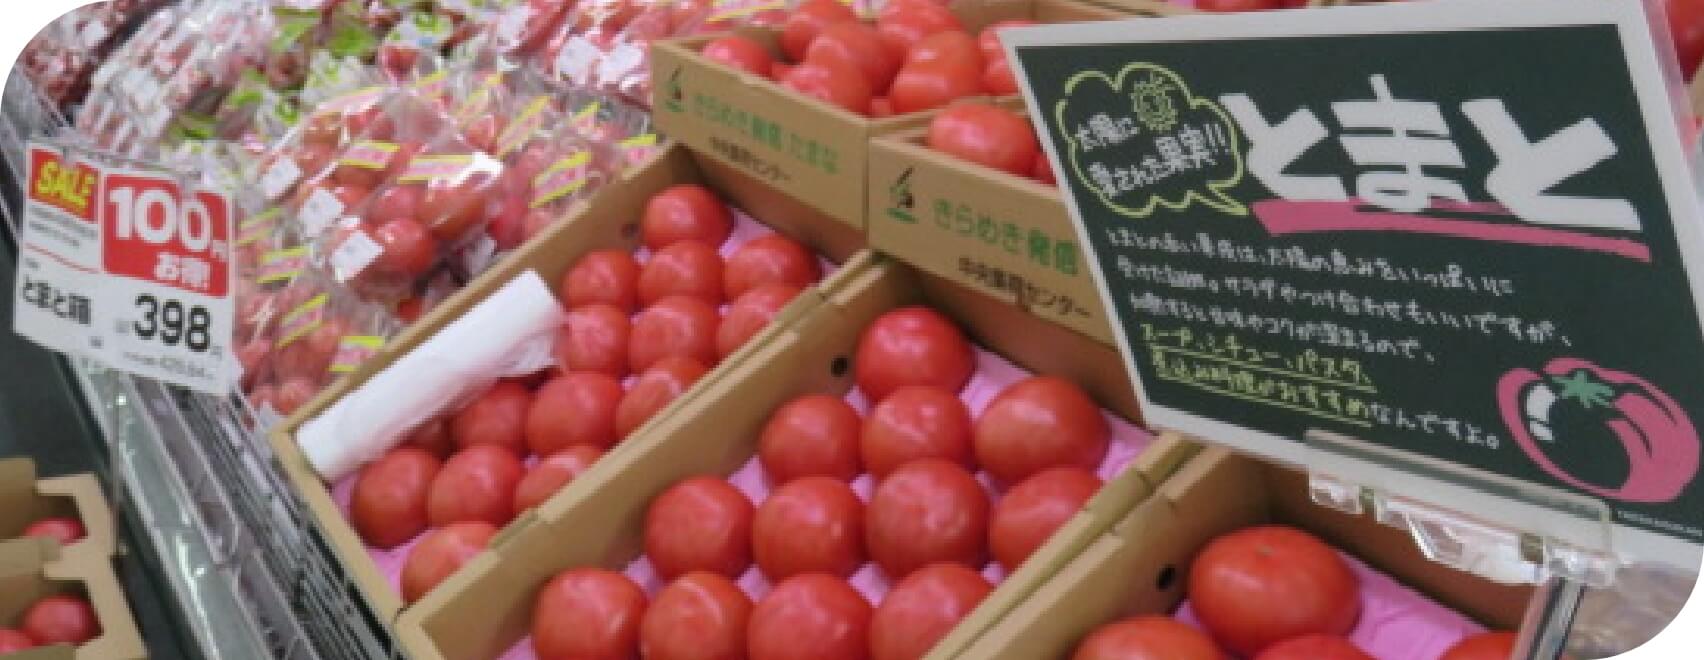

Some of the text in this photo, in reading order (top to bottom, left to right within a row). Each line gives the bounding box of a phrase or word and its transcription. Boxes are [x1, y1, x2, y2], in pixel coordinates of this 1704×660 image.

[1218, 74, 1642, 231] とまと
[37, 161, 95, 213] SALE
[109, 186, 211, 251] 100
[133, 293, 211, 352] 398
